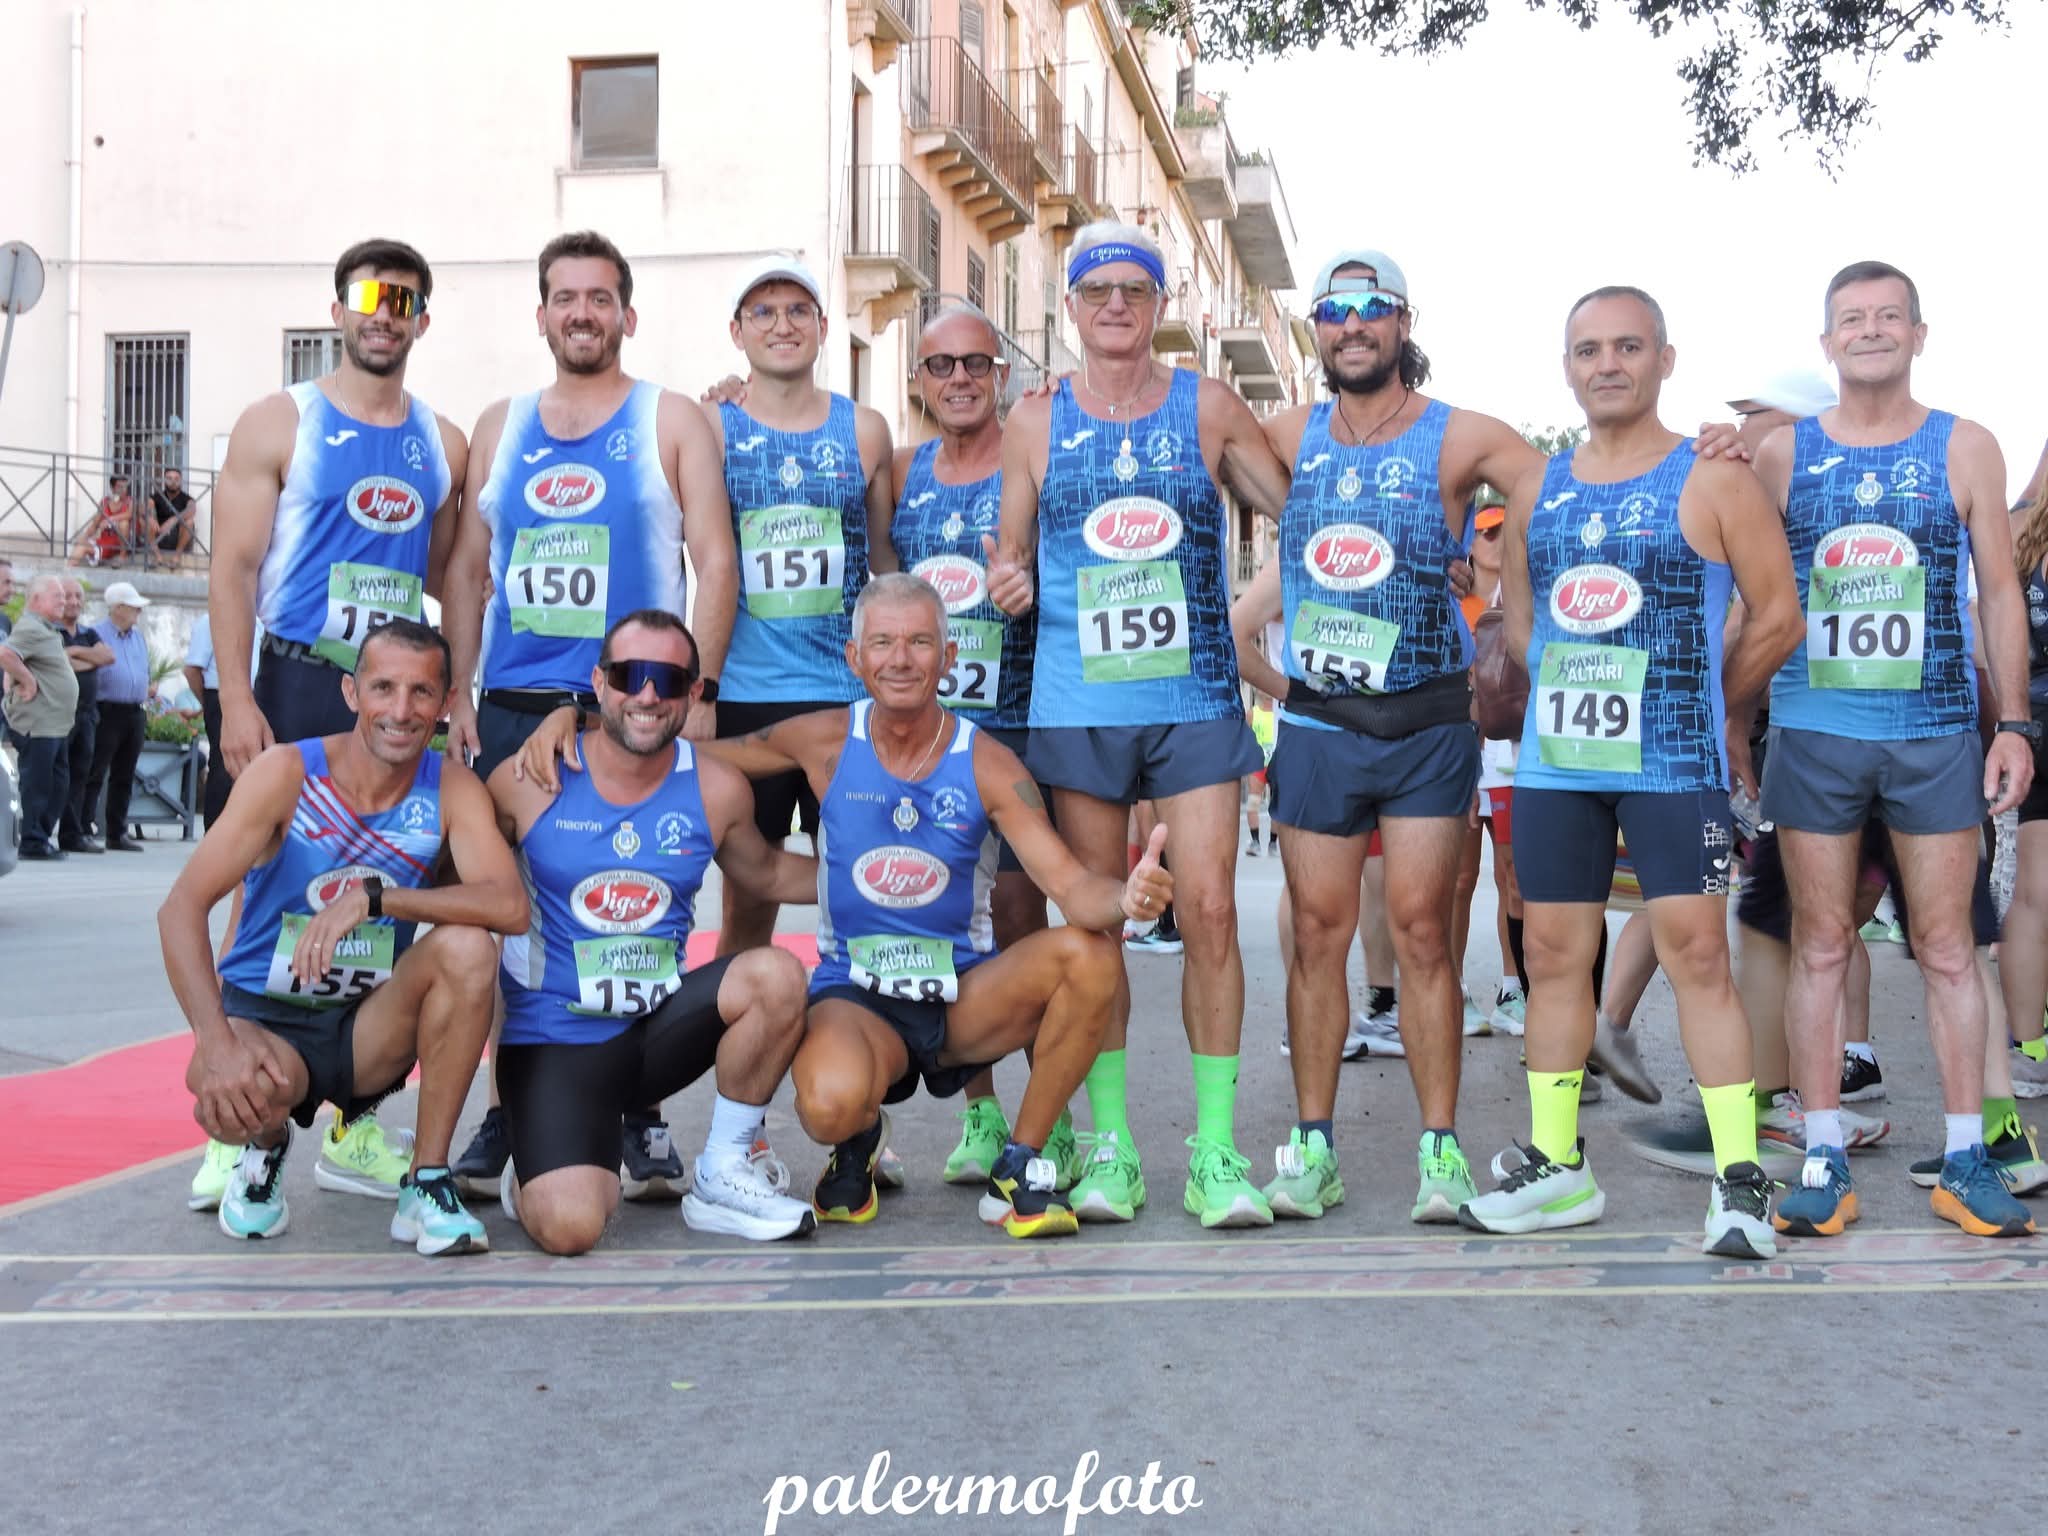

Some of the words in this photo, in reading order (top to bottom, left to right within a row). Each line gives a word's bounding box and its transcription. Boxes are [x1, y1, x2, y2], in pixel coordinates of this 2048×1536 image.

[541, 473, 592, 506] Sigel
[361, 486, 412, 520] Sigel
[771, 522, 824, 544] ALTARI
[1104, 507, 1166, 547] Sigel
[535, 539, 591, 560] ALTARI
[1319, 535, 1378, 576] Sigel
[755, 548, 829, 590] 151
[1109, 572, 1141, 589] PANI
[518, 566, 596, 606] 150
[1110, 578, 1164, 603] ALTARI
[1841, 574, 1879, 594] PANI
[1881, 572, 1892, 585] E
[1841, 583, 1905, 606] ALTARI
[358, 587, 409, 604] ALTARI
[1561, 576, 1623, 617] Sigel
[1091, 605, 1176, 652] 159
[1322, 619, 1353, 634] PANI
[1358, 620, 1367, 633] E
[1822, 613, 1911, 658] 160
[1318, 629, 1375, 649] ALTARI
[1567, 654, 1602, 669] PANI
[1605, 652, 1614, 666] E
[1568, 663, 1623, 684] ALTARI
[1549, 690, 1629, 738] 149
[871, 855, 934, 894] Sigel
[592, 880, 656, 920] Sigel
[613, 953, 660, 972] ALTARI
[880, 944, 910, 961] PANI
[913, 943, 922, 954] E
[880, 953, 934, 973] ALTARI
